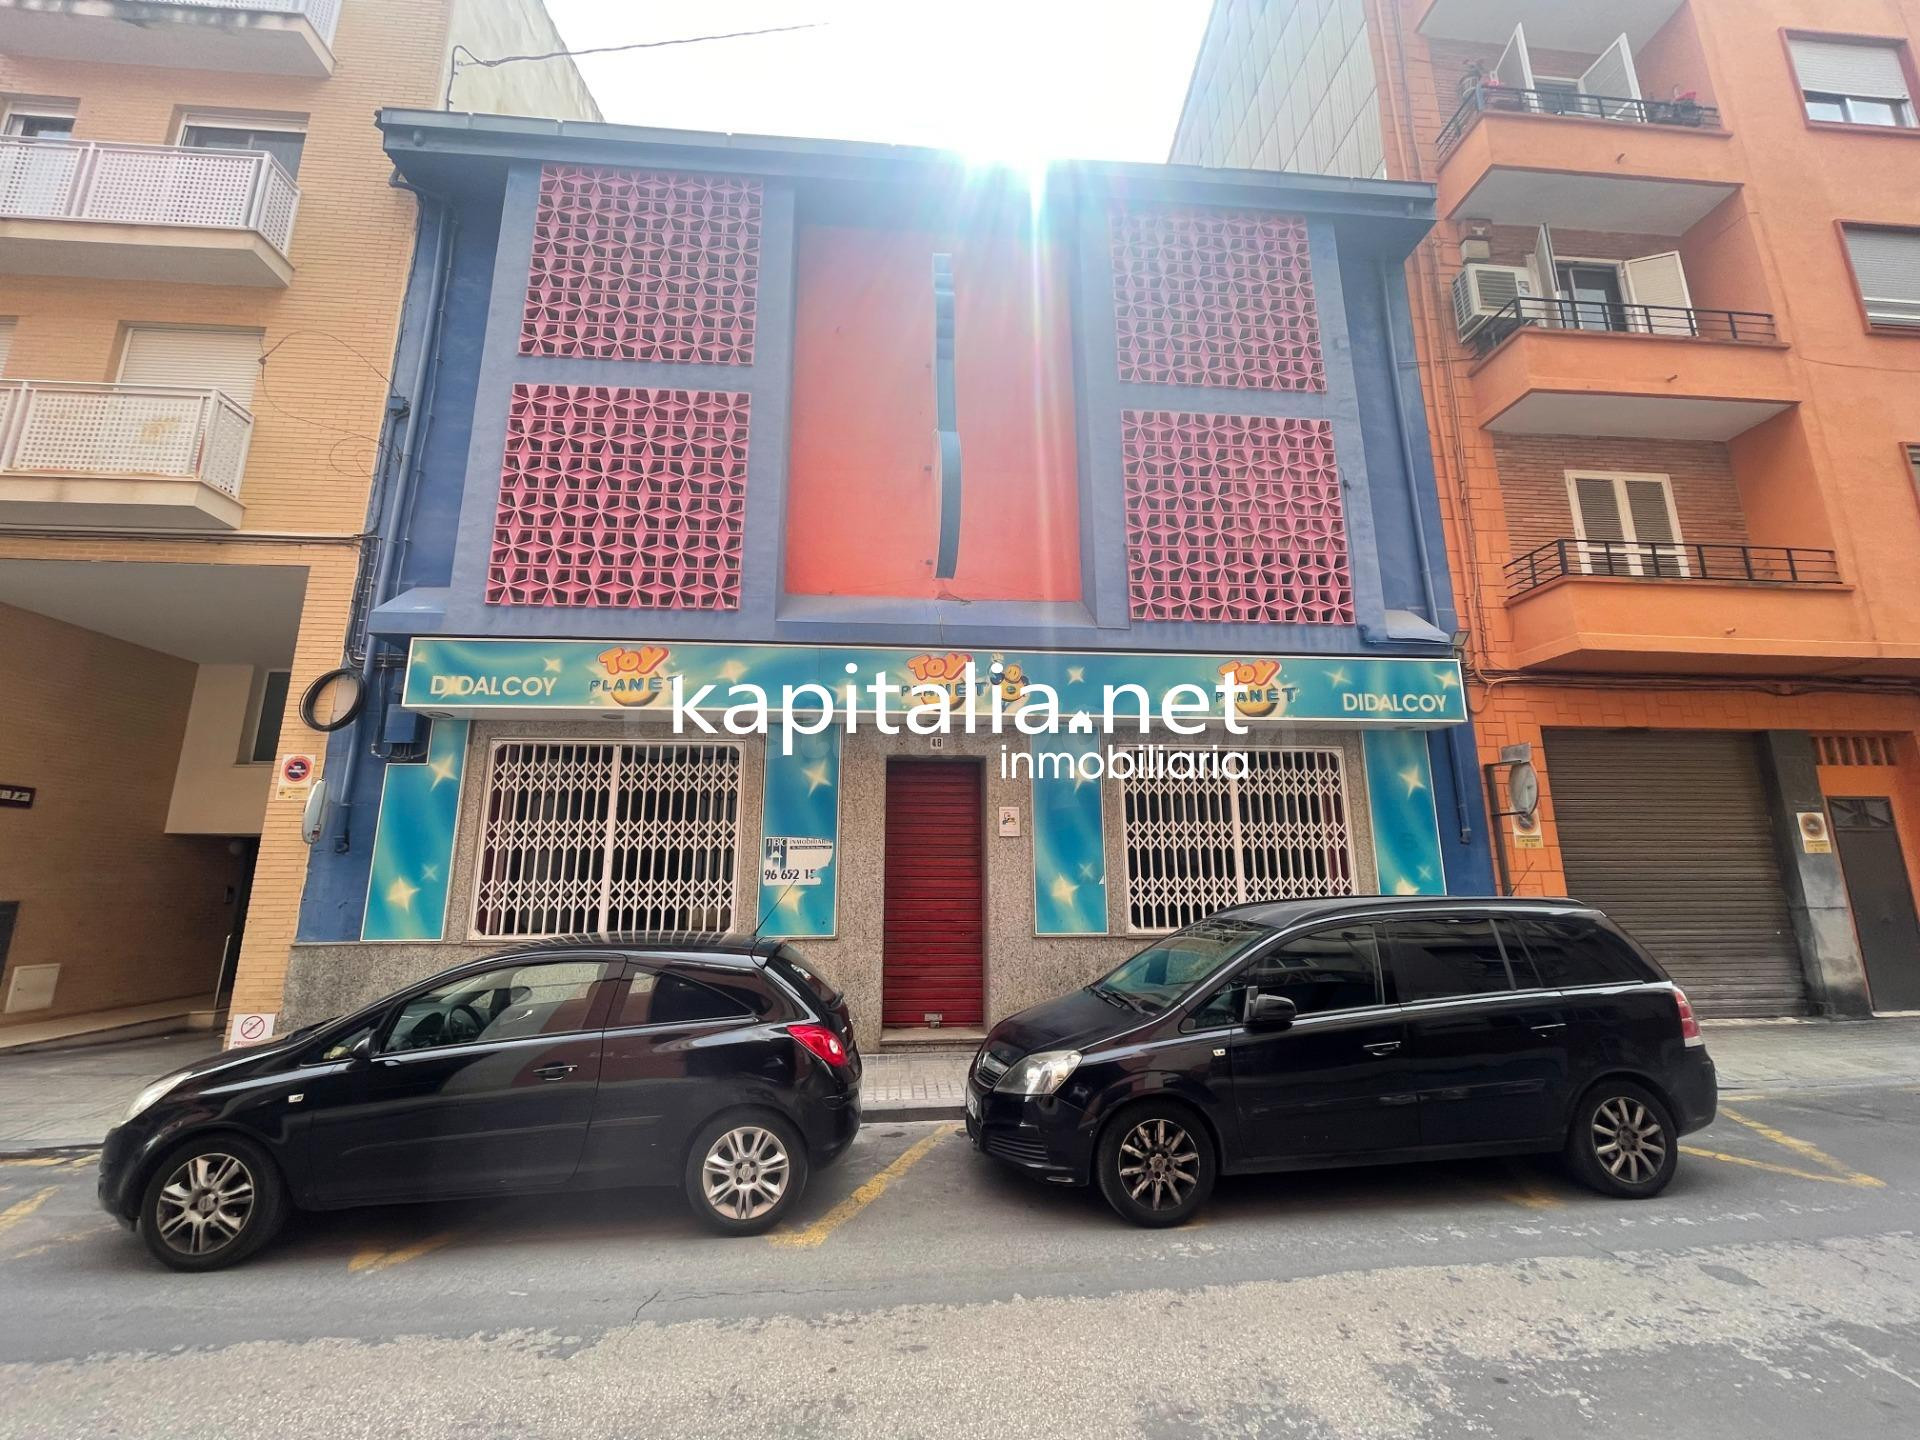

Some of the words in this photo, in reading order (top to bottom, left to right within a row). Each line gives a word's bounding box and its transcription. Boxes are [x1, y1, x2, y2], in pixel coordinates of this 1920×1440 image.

[598, 646, 670, 675] TOY
[907, 653, 973, 681] TOY
[429, 675, 558, 696] DIDALCOY
[901, 682, 988, 697] PET
[1215, 687, 1299, 704] PANET
[1341, 692, 1447, 713] DIDALCOY
[931, 738, 942, 748] 48
[764, 868, 778, 880] 96
[780, 868, 800, 880] 652
